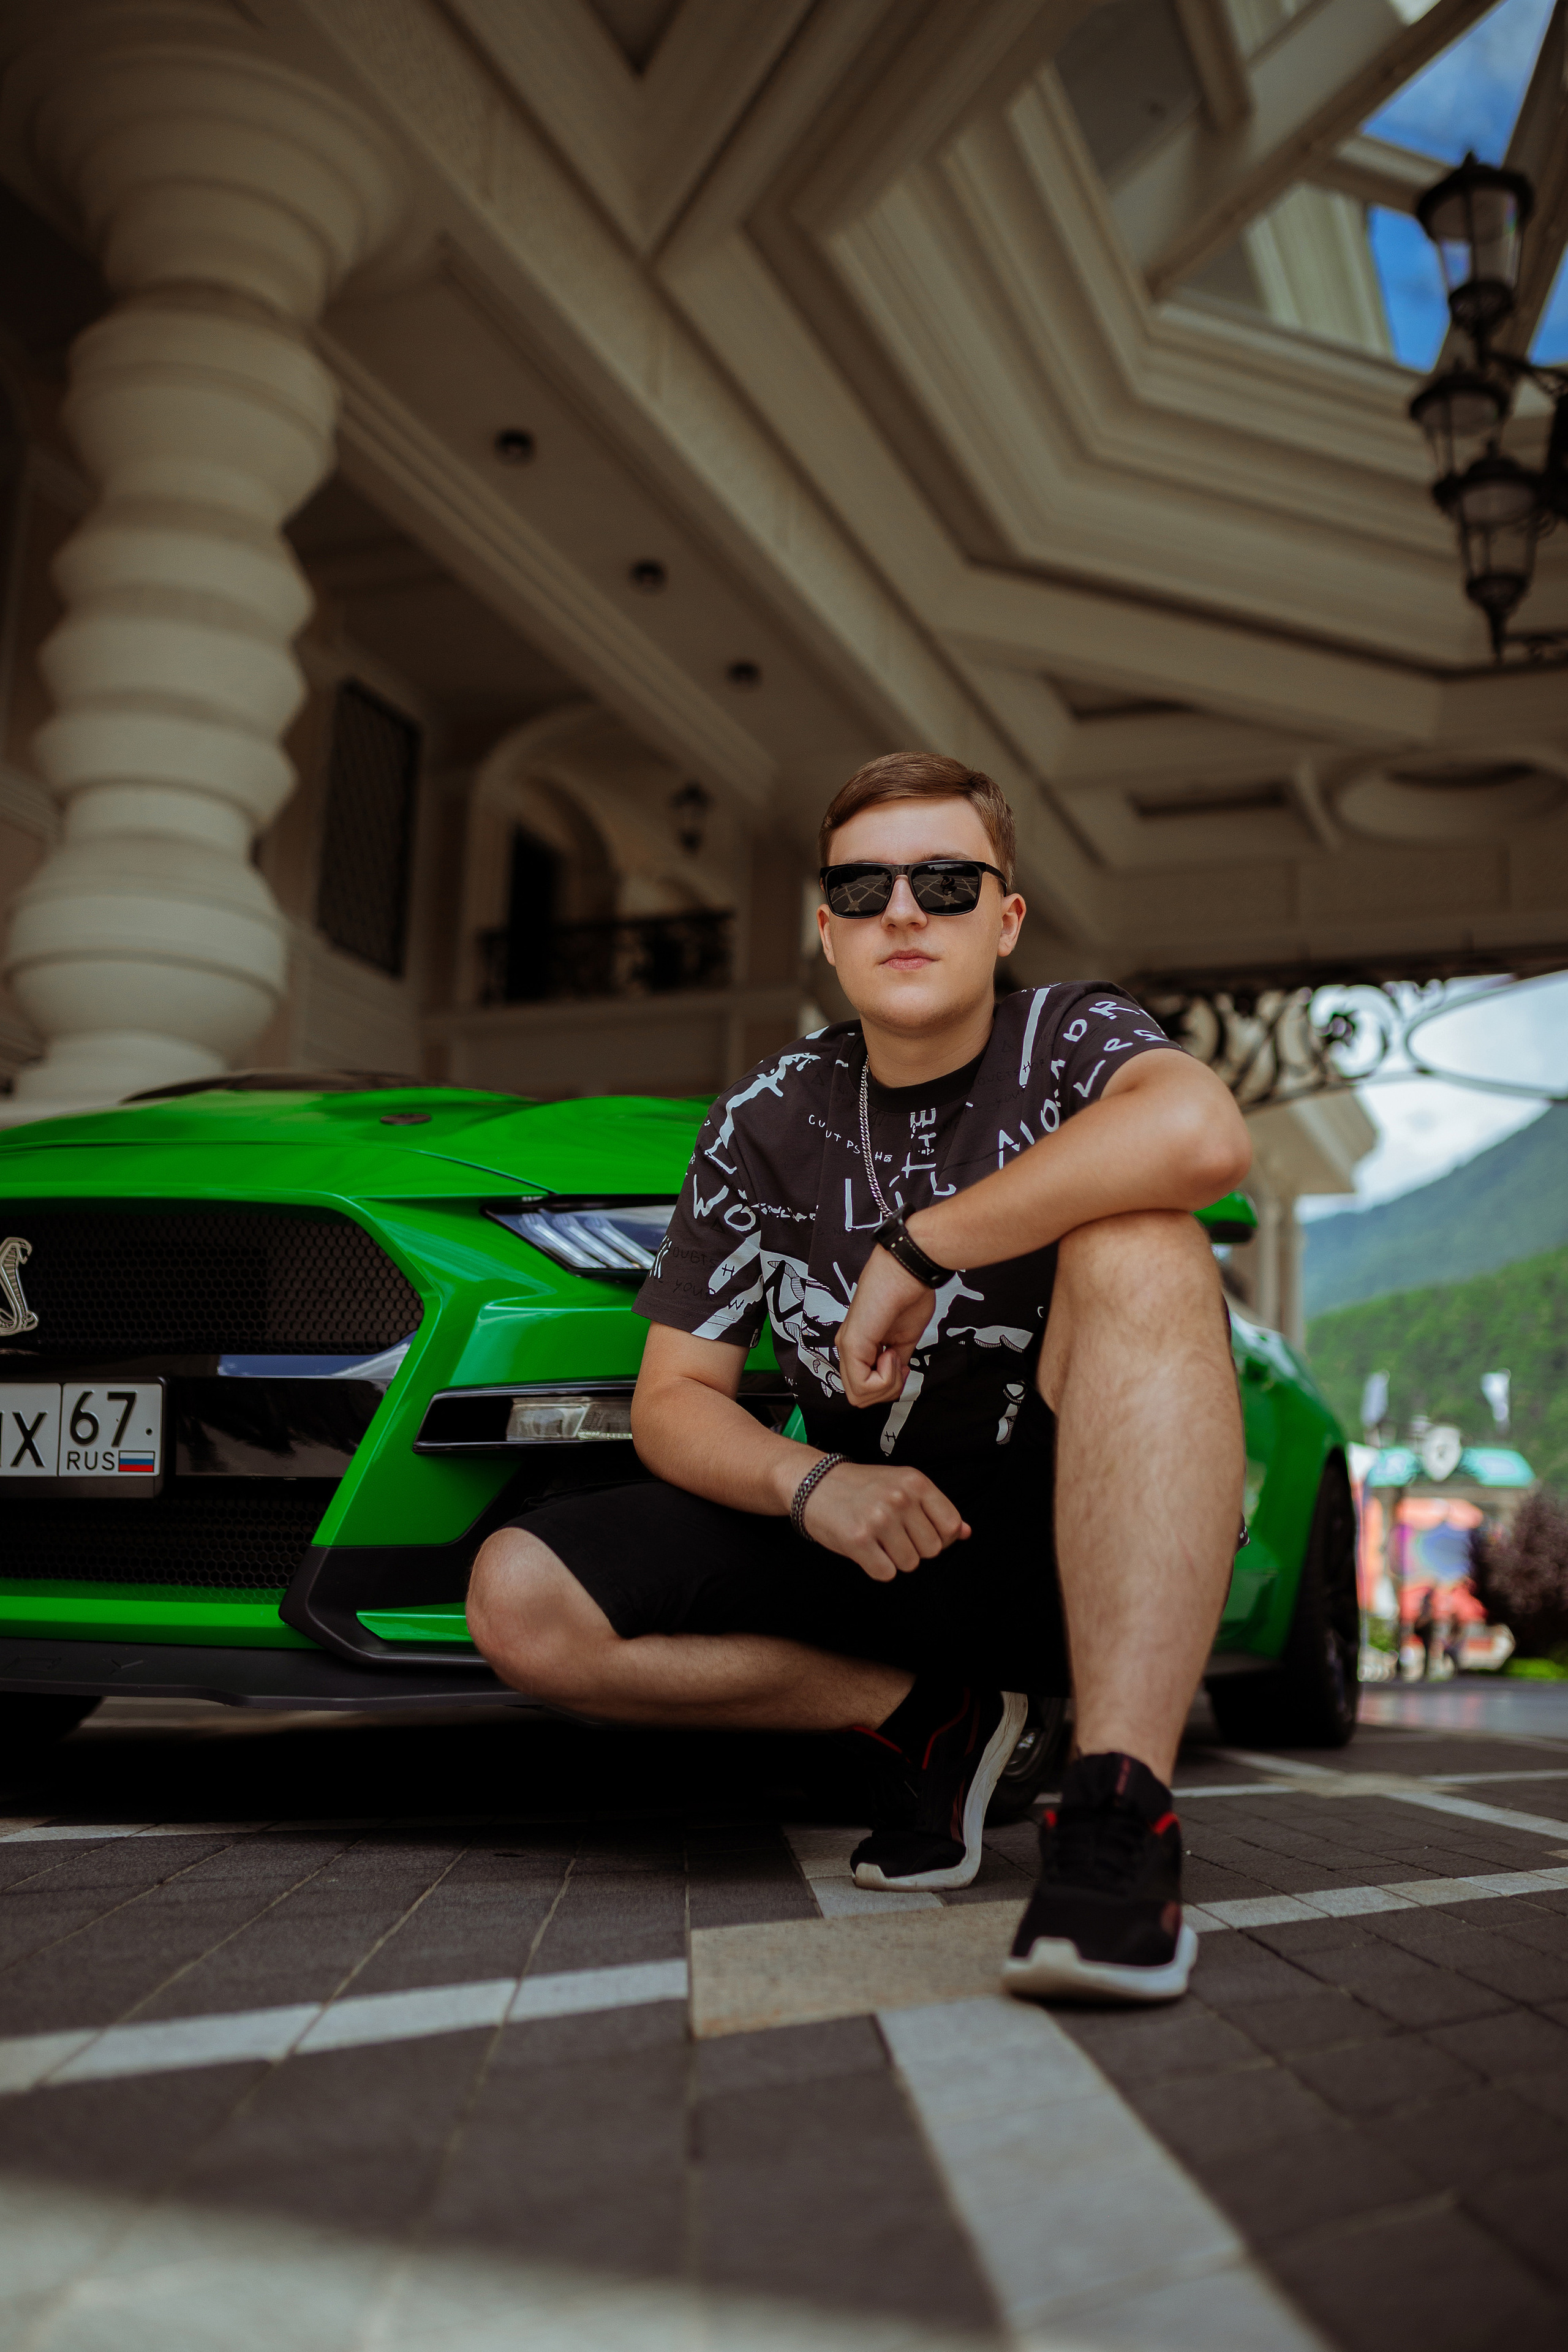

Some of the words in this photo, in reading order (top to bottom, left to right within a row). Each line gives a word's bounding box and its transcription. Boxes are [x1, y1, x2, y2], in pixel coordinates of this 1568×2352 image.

[0, 1410, 48, 1468] X
[69, 1390, 137, 1447] 67
[66, 1450, 115, 1471] RUS
